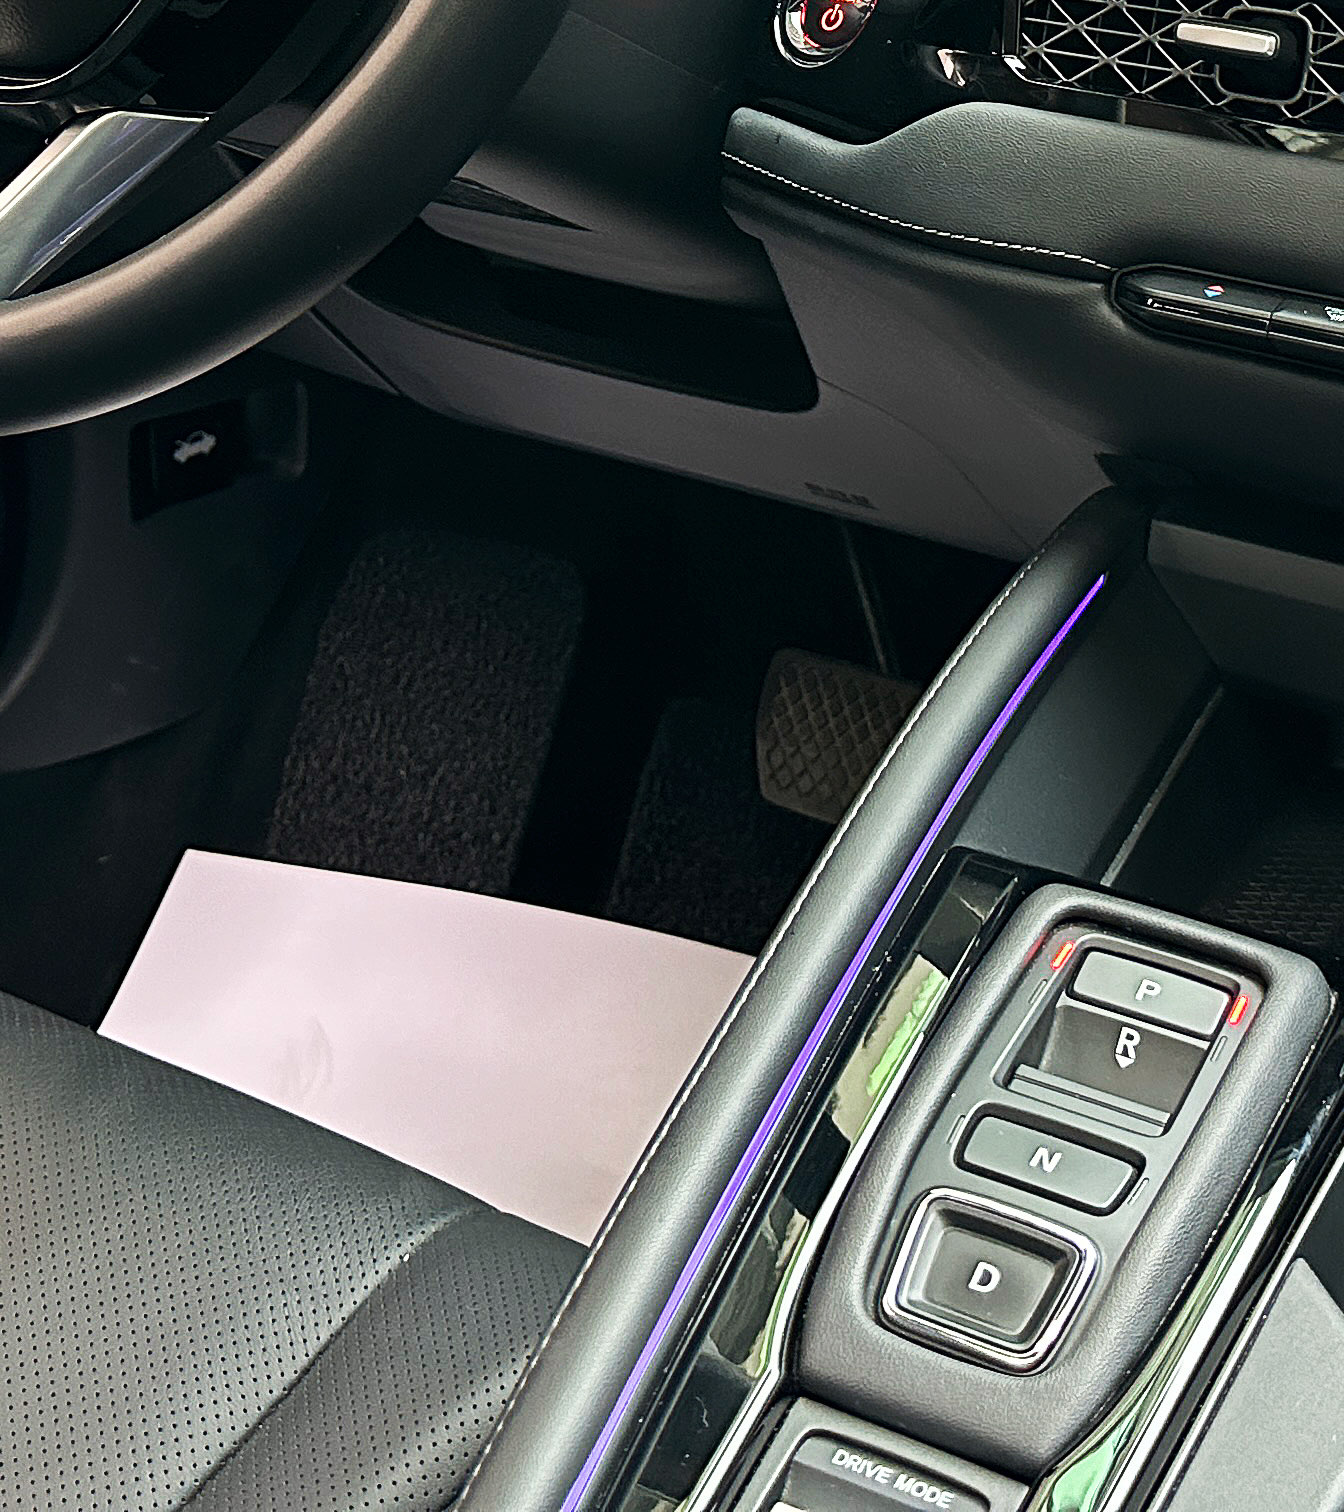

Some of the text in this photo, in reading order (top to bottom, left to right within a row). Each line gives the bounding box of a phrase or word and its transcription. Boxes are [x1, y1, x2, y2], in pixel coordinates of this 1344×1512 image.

[1134, 978, 1162, 1002] P
[1115, 1026, 1142, 1060] R
[1028, 1146, 1063, 1172] N
[968, 1260, 1002, 1293] D
[831, 1448, 955, 1510] DRIVE MODE
